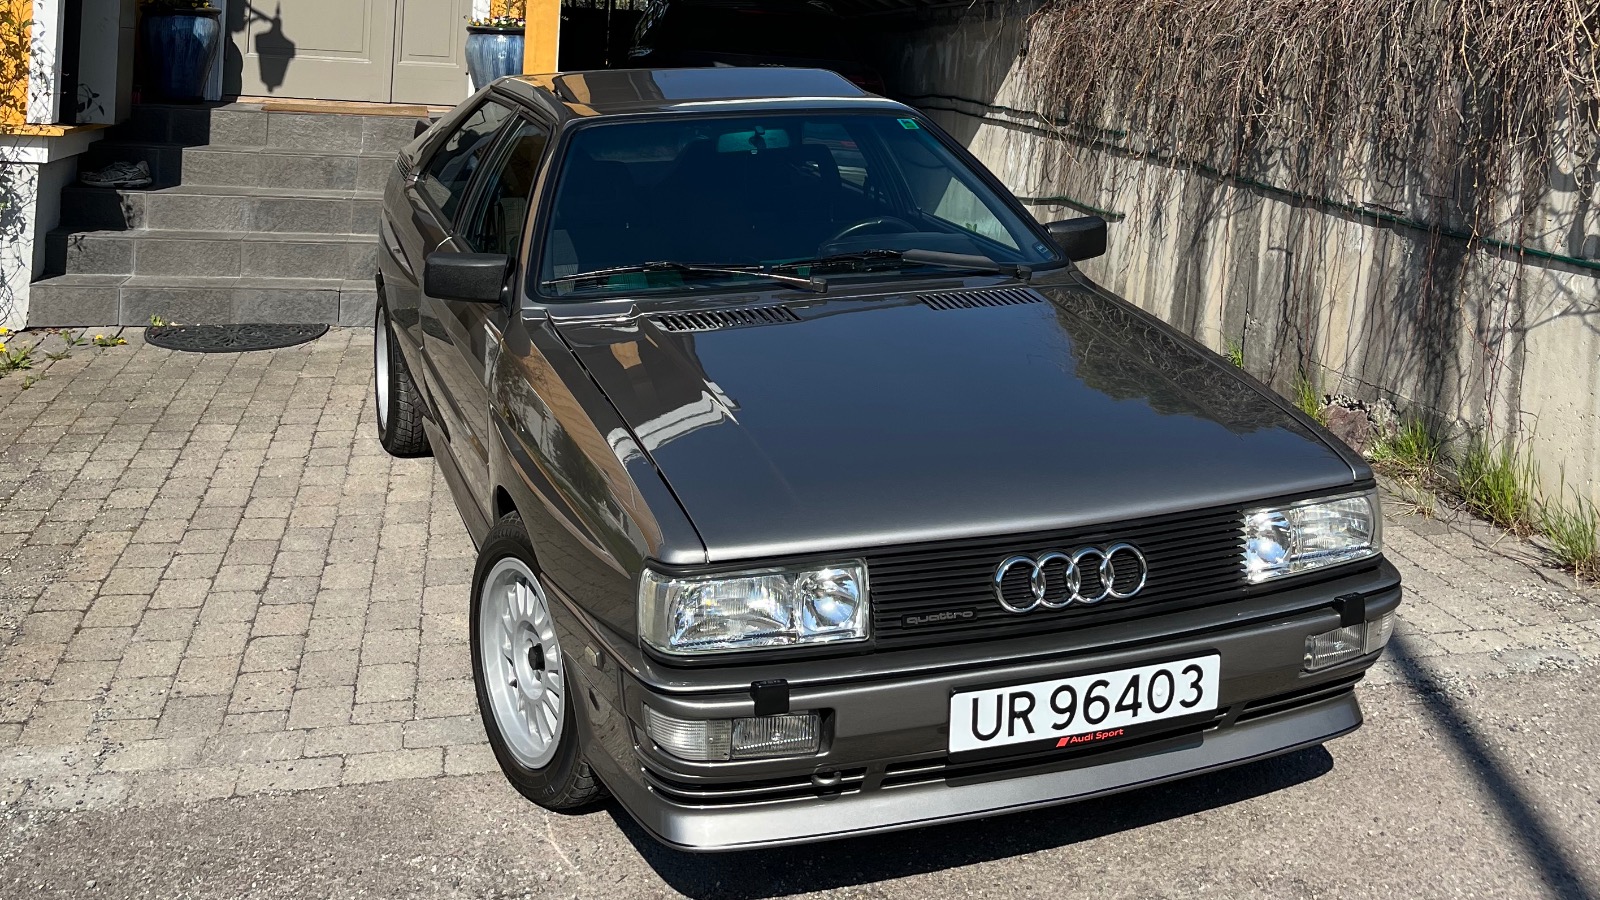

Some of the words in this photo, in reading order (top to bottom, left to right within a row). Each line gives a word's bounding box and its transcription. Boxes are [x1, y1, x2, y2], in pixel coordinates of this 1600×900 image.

[906, 610, 974, 625] quattro
[971, 691, 1036, 741] UR
[1050, 664, 1204, 731] 96403
[1069, 733, 1094, 744] Audi
[1095, 728, 1124, 740] Sport
